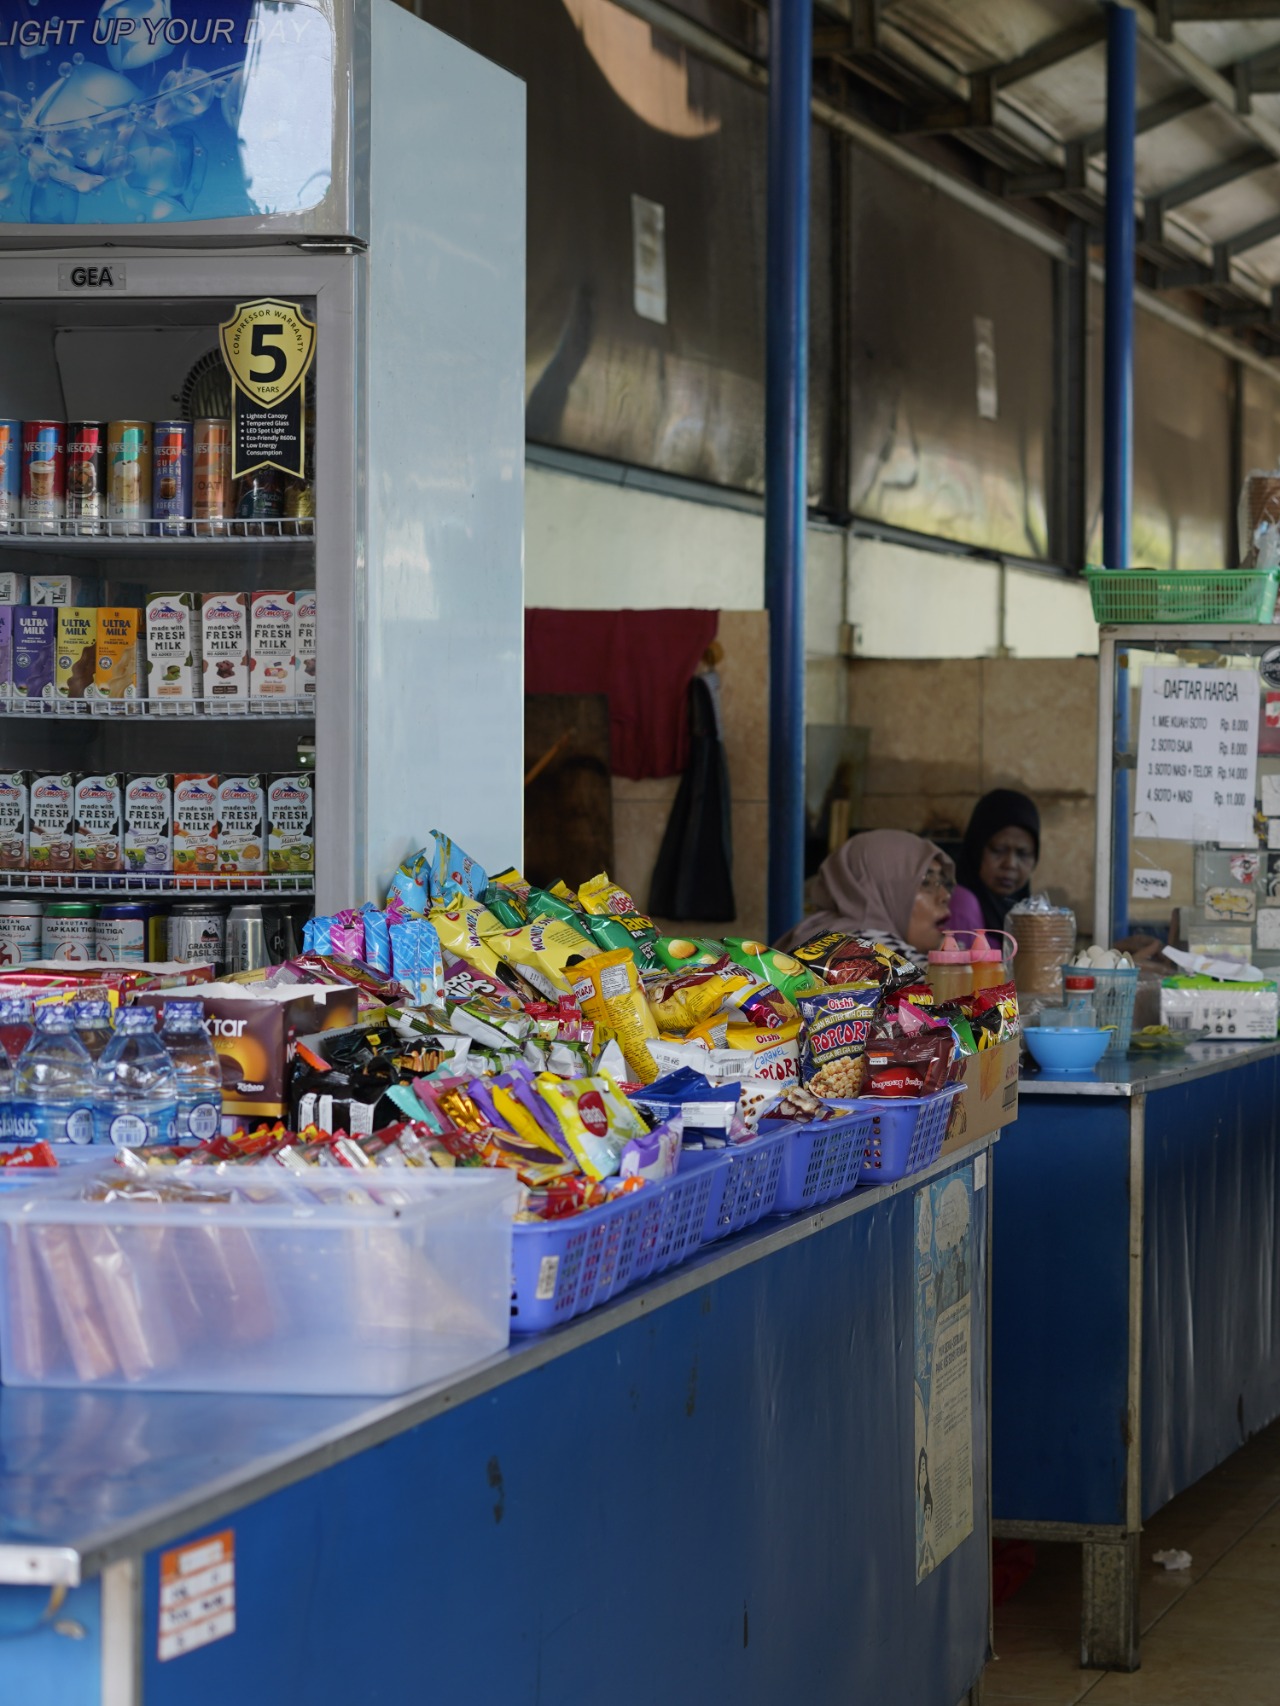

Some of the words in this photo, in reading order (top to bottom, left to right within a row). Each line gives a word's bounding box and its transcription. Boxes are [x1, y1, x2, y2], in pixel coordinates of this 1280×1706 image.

[91, 18, 135, 45] UP
[143, 17, 235, 45] YOUR
[243, 18, 311, 44] DAY
[71, 266, 113, 288] GEA
[233, 309, 271, 355] COMPRESSOR
[274, 310, 304, 353] WARRANTY
[249, 324, 288, 383] 5
[257, 427, 270, 435] Spot
[271, 427, 285, 435] Light
[258, 442, 277, 450] Energy
[20, 618, 48, 627] ULTRA
[62, 619, 91, 628] ULTRA
[102, 620, 131, 628] ULTRA
[23, 626, 45, 635] MILK
[65, 628, 87, 636] MILK
[106, 628, 127, 636] MILK
[206, 631, 242, 639] FRESH
[254, 629, 292, 638] FRESH
[150, 631, 186, 640] FRESH
[155, 642, 182, 650] MILK
[211, 641, 238, 649] MILK
[259, 640, 287, 648] MILK
[1163, 679, 1203, 700] DAFTAR
[1203, 681, 1239, 702] HARGA
[1158, 739, 1176, 752] SOTO
[34, 809, 69, 817] FRESH
[79, 810, 115, 818] FRESH
[129, 811, 165, 819] FRESH
[178, 812, 214, 820] FRESH
[221, 811, 258, 820] FRESH
[272, 811, 308, 819] FRESH
[38, 819, 65, 828] MILK
[84, 820, 111, 829] MILK
[133, 821, 160, 829] MILK
[182, 822, 210, 830] MILK
[226, 821, 253, 830] MILK
[277, 821, 304, 830] MILK
[608, 914, 653, 931] Taro
[529, 925, 546, 951] MONDE
[187, 949, 211, 959] BASIL
[828, 997, 855, 1010] Oishi
[755, 1033, 781, 1044] Oishi
[755, 1057, 800, 1080] PCORN
